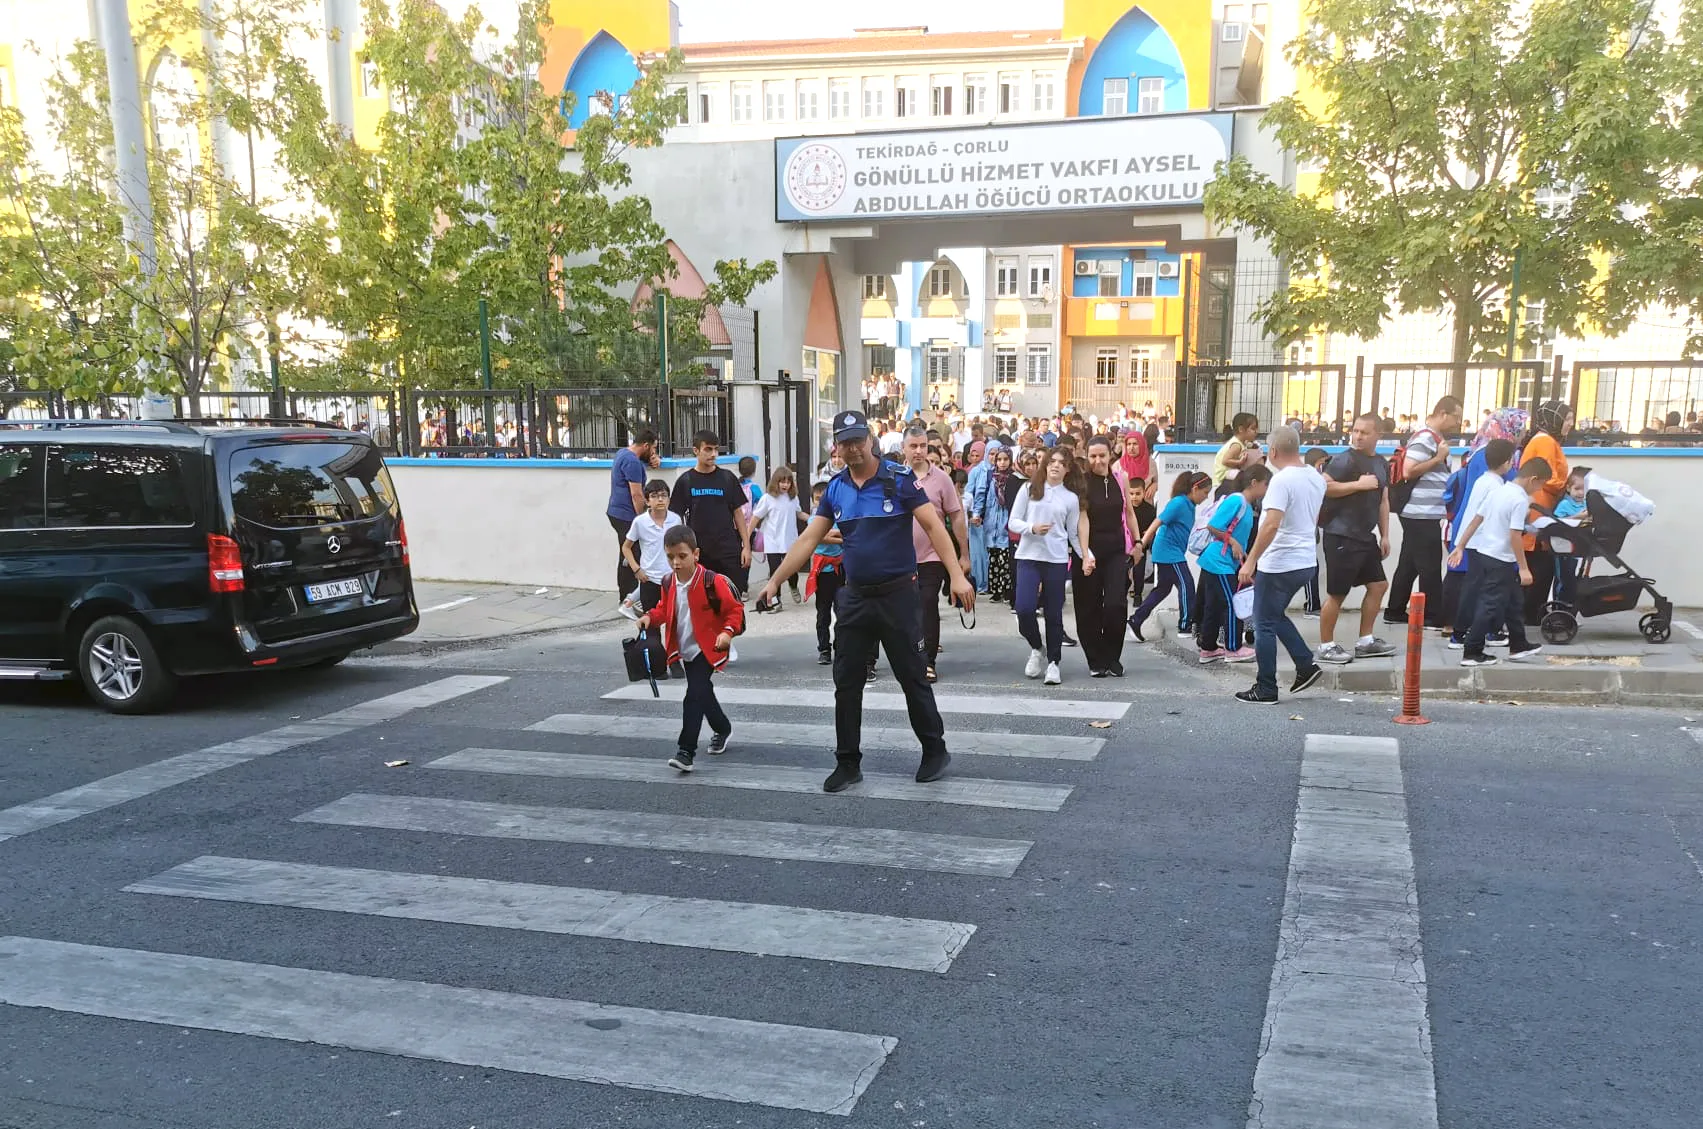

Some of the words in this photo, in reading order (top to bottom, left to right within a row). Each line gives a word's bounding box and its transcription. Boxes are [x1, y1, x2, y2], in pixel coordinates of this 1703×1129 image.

[856, 141, 938, 159] TEKİRDAĞ
[953, 140, 1009, 156] ÇORLU
[853, 163, 953, 187] GÖNÜLLÜ
[961, 161, 1044, 182] HİZMET
[1050, 158, 1118, 178] VAKFI
[1124, 154, 1200, 174] AYSEL
[853, 193, 969, 213] ABDULLAH
[975, 185, 1051, 208] ÖĞÜCÜ
[1057, 182, 1199, 205] ORTAOKULU
[311, 587, 323, 599] 59
[327, 584, 342, 597] ACM
